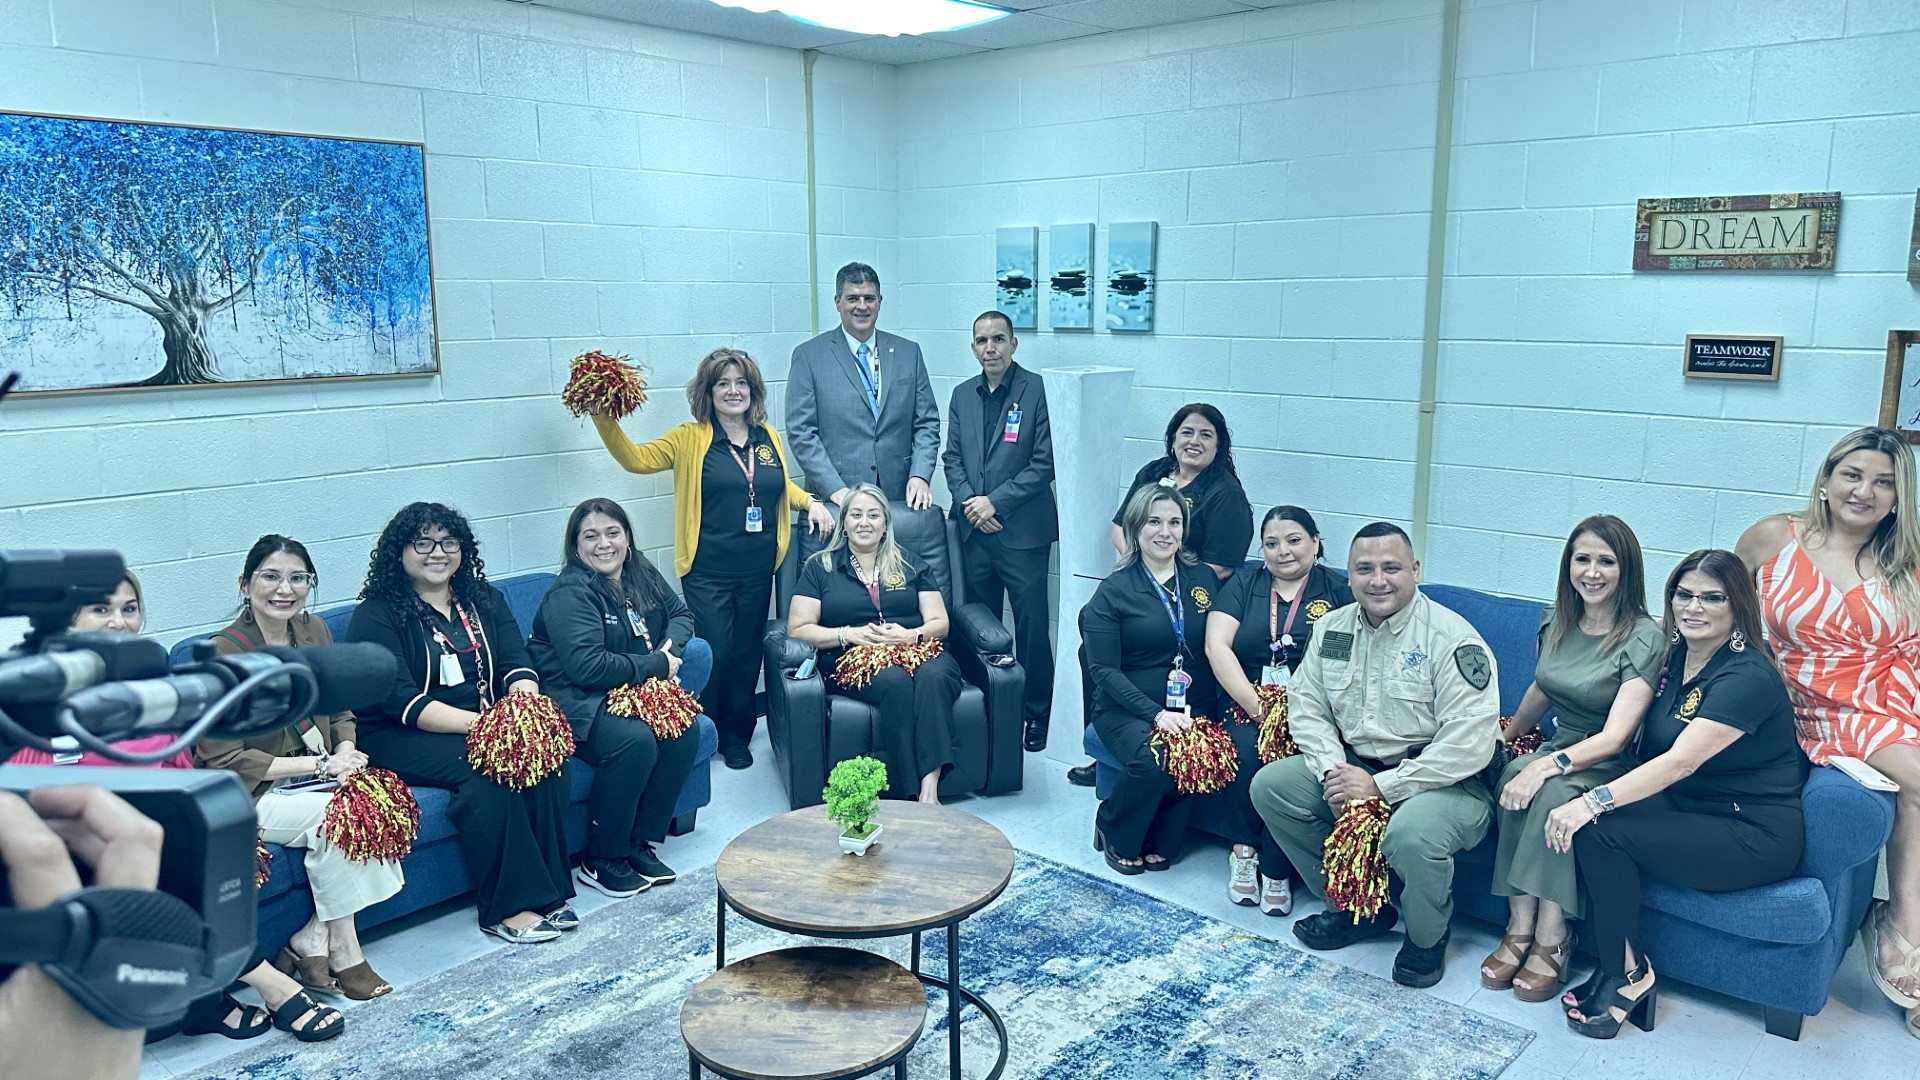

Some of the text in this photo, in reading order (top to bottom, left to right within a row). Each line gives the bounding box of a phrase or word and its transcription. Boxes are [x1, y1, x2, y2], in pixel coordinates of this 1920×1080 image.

[1656, 214, 1811, 250] DREAM
[1694, 344, 1771, 357] TEAMWORK
[1319, 648, 1350, 660] AGUILAR
